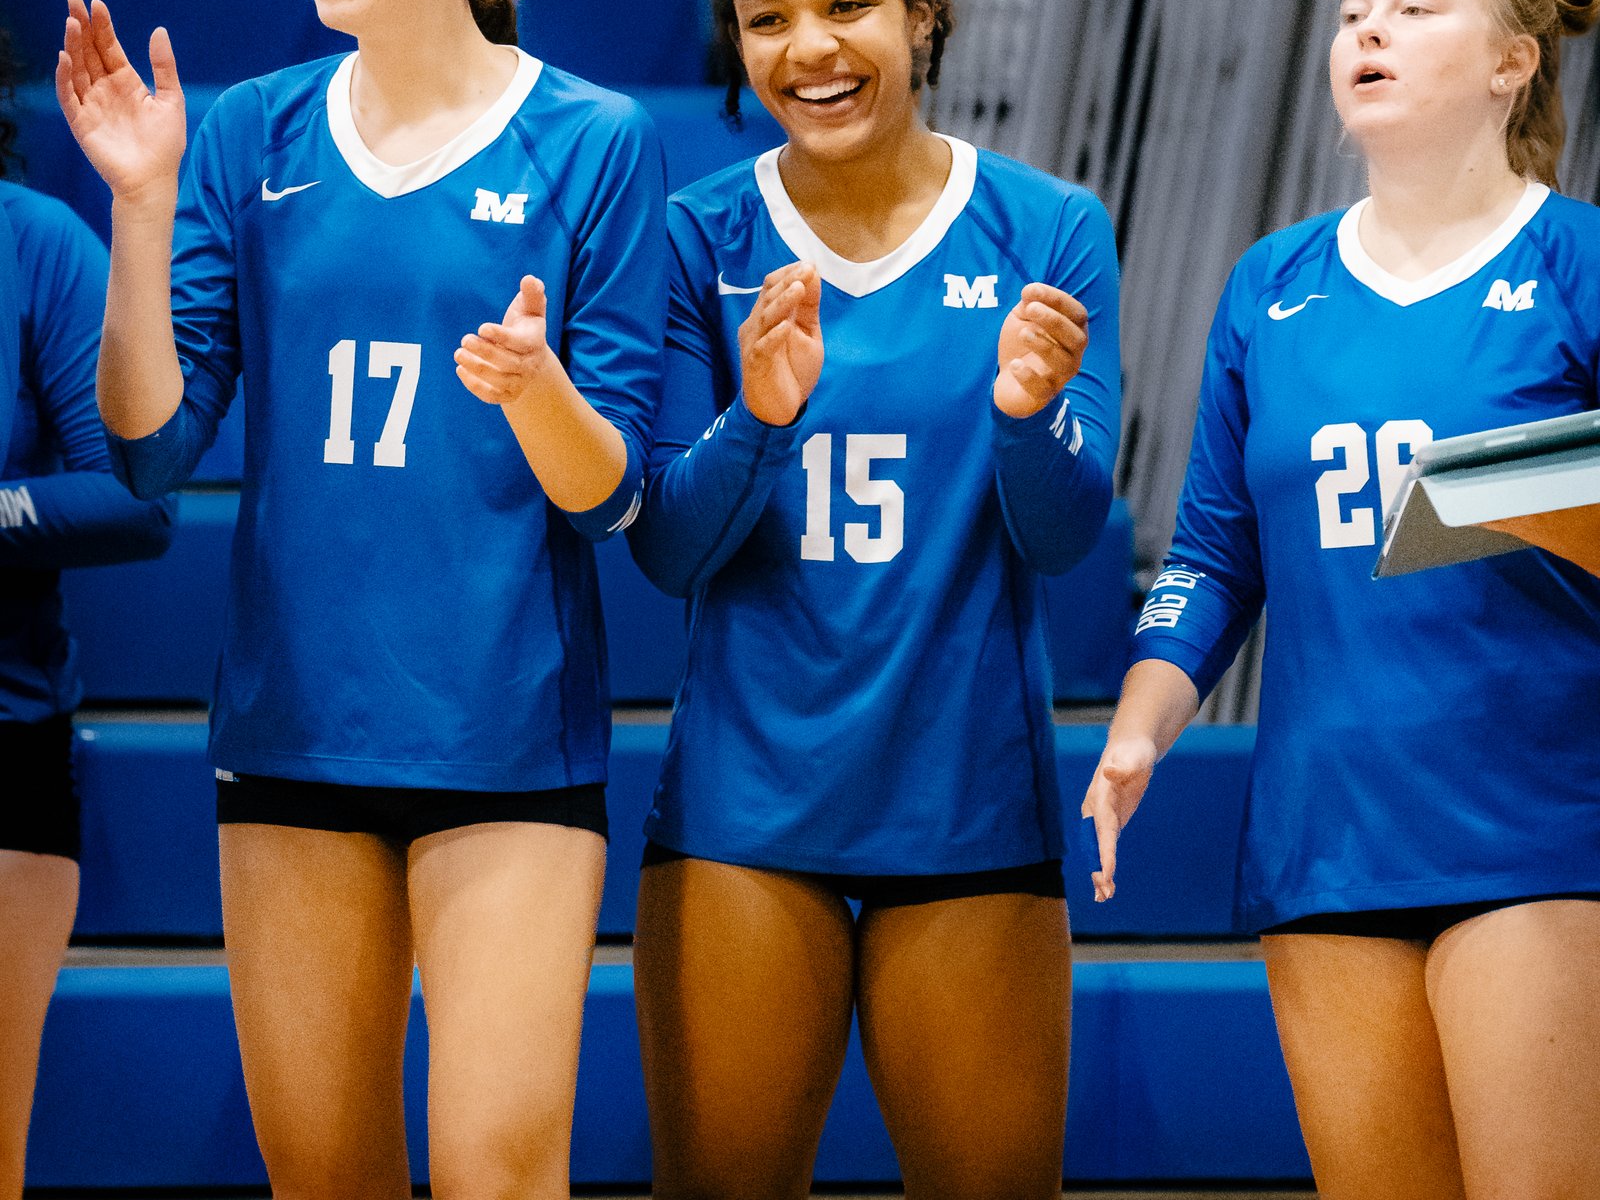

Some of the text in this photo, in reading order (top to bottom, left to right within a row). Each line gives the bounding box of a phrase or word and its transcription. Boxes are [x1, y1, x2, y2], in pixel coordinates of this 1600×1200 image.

[470, 187, 529, 224] M
[943, 273, 999, 309] M
[1481, 278, 1538, 312] M
[323, 339, 422, 468] 17
[800, 433, 907, 563] 15
[1134, 593, 1188, 636] BIG
